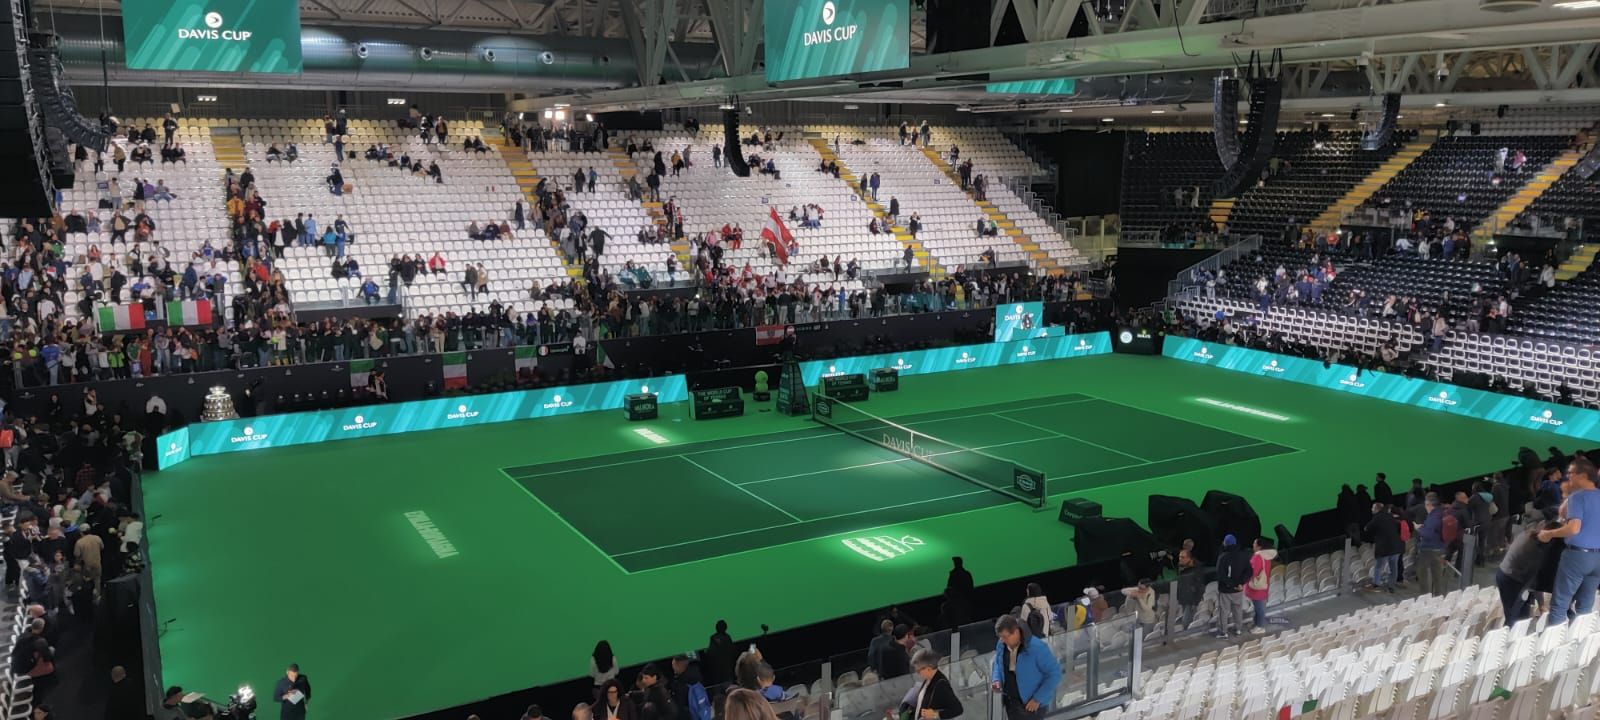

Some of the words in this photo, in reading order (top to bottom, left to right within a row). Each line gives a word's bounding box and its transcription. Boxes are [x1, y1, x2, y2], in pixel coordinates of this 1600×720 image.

[178, 28, 219, 39] DAVIS
[221, 30, 251, 41] CUP
[804, 28, 832, 46] DAVIS
[834, 25, 857, 41] CUP
[882, 433, 911, 453] DAVIS
